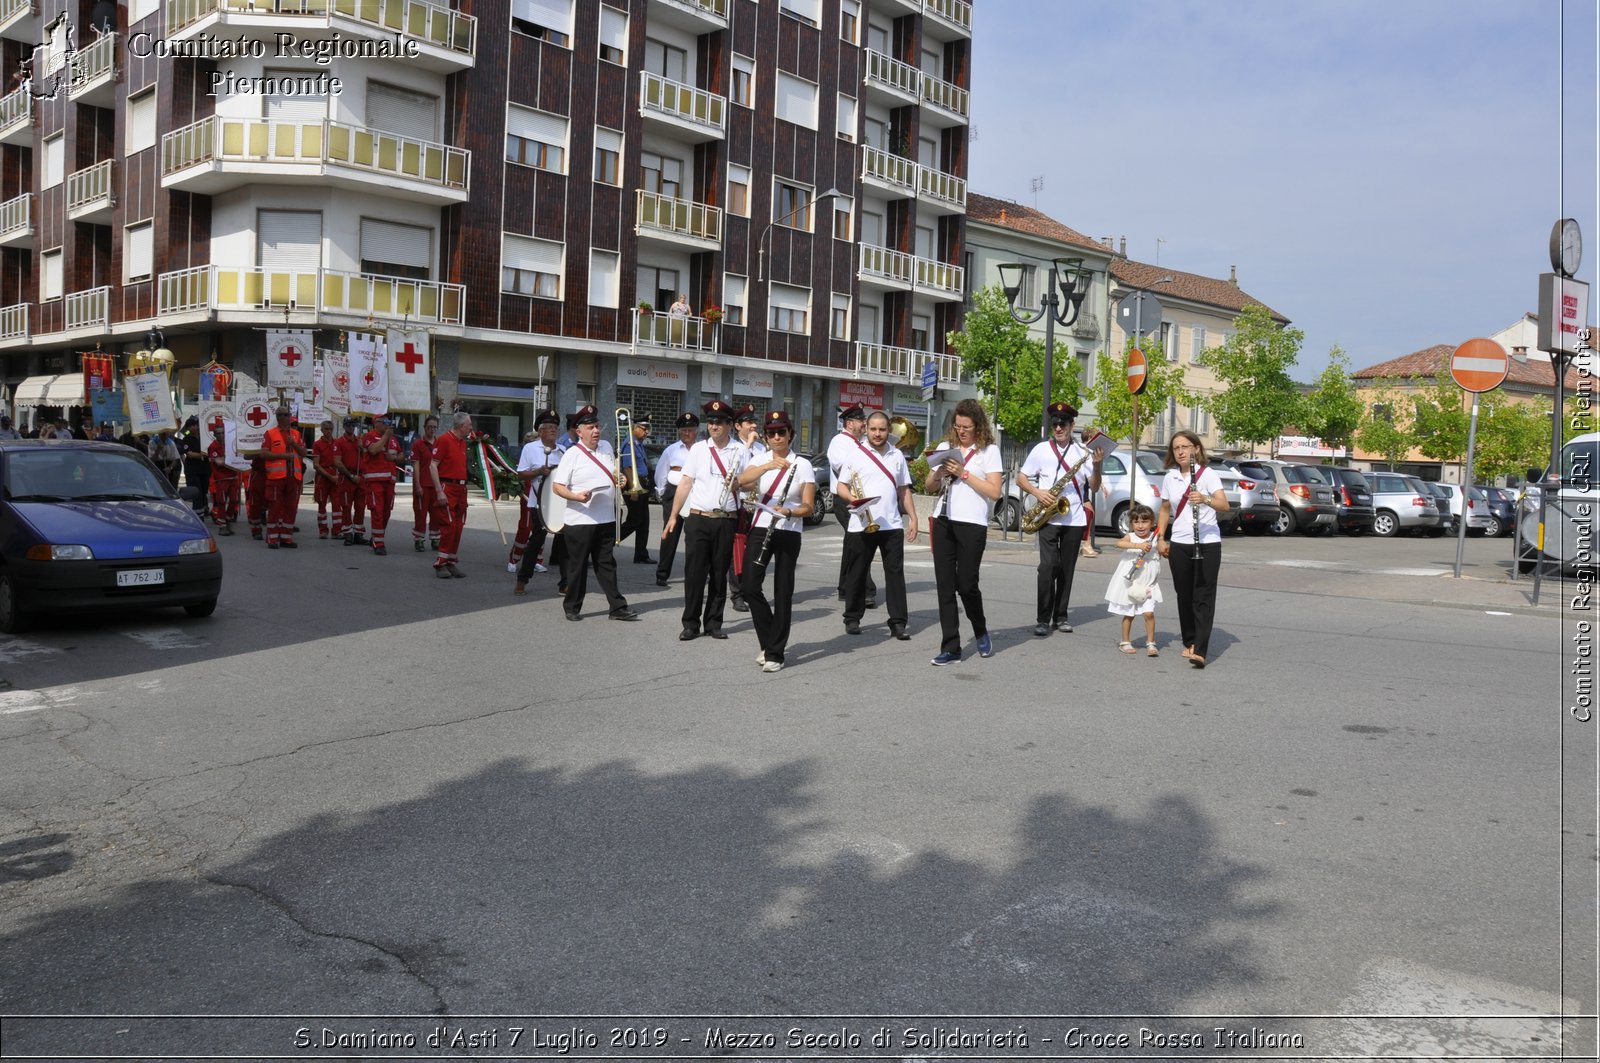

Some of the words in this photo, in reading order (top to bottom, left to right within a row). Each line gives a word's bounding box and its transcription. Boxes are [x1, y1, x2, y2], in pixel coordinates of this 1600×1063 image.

[627, 368, 648, 377] audio
[655, 370, 680, 380] sanitas
[734, 378, 750, 386] audio
[118, 574, 128, 583] AT
[133, 573, 149, 582] 762
[153, 572, 163, 581] JX
